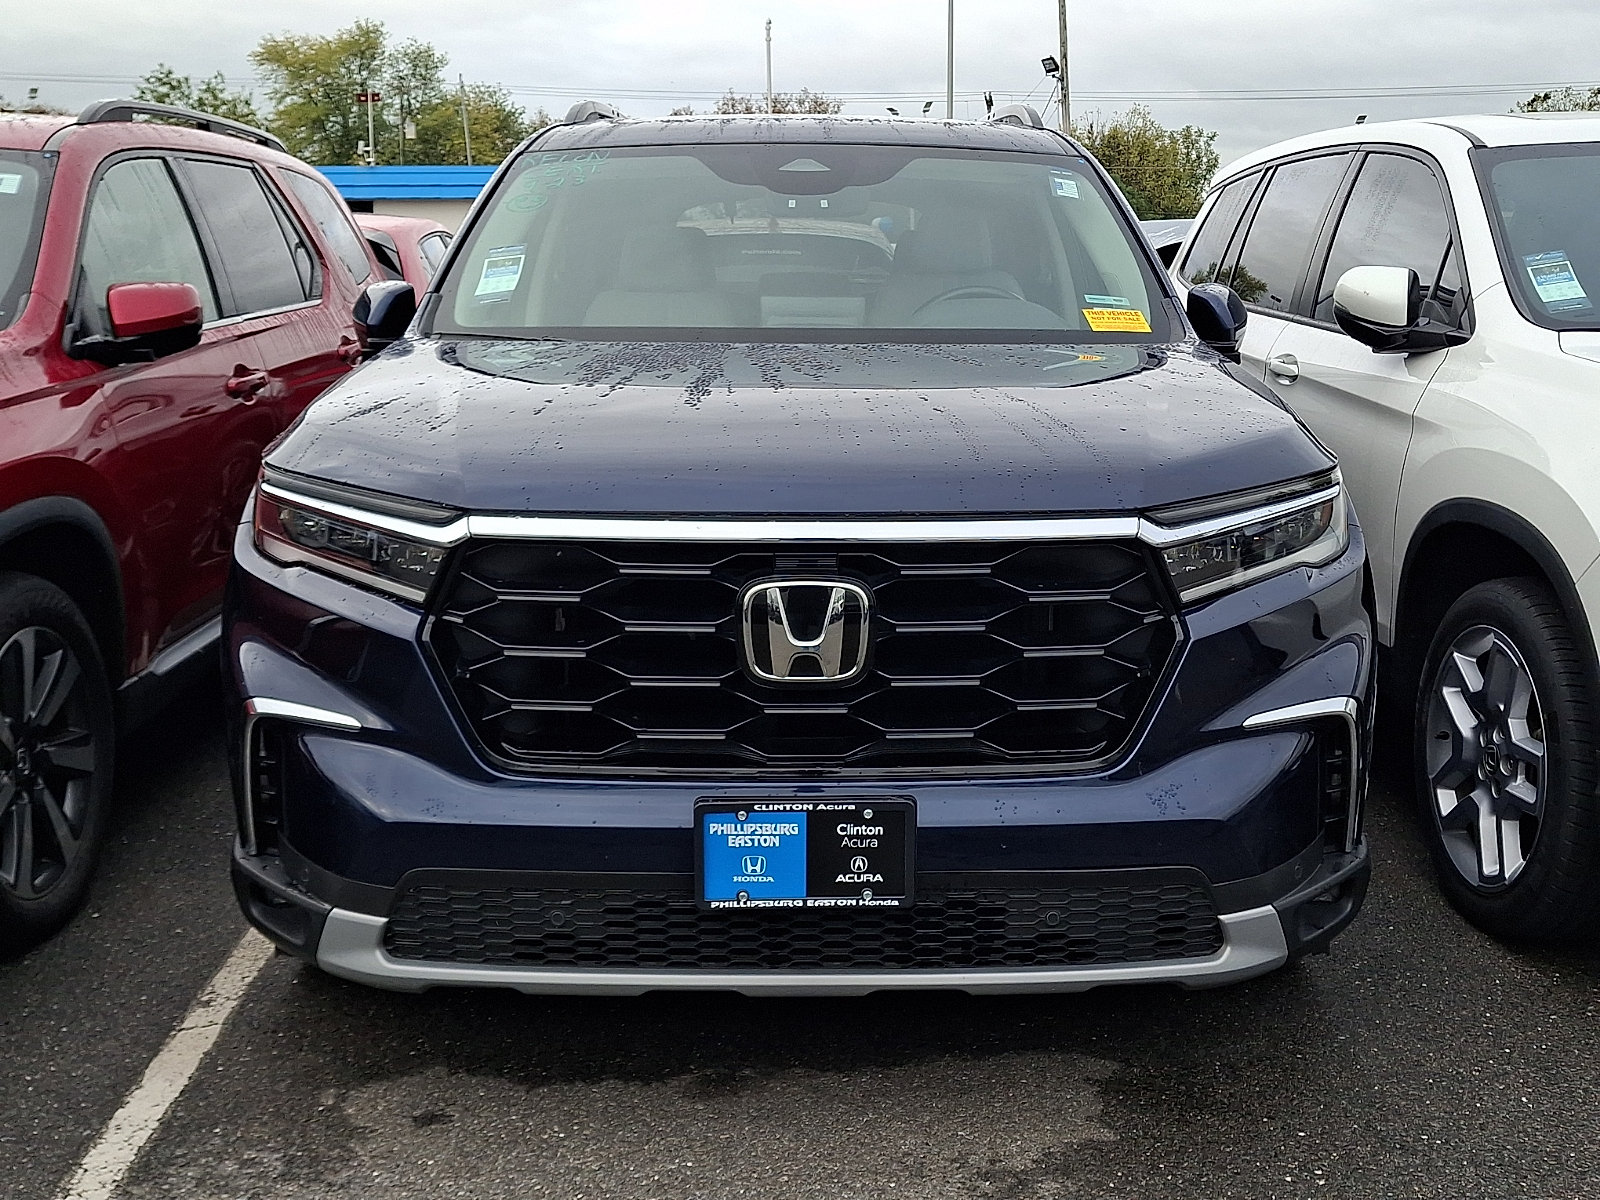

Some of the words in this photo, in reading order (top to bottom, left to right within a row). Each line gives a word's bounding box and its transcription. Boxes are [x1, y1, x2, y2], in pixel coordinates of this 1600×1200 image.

[753, 803, 813, 811] CLINTON
[816, 803, 856, 811] Acura
[709, 823, 799, 836] PHILLIPSBURG
[836, 823, 884, 836] Clinton
[728, 836, 780, 848] EASTON
[840, 836, 878, 848] Acura
[732, 875, 775, 883] HONDA
[835, 873, 884, 883] ACURA
[710, 900, 804, 909] PHILLIPSBURG
[806, 899, 857, 907] EASTON
[858, 898, 900, 907] Honda
